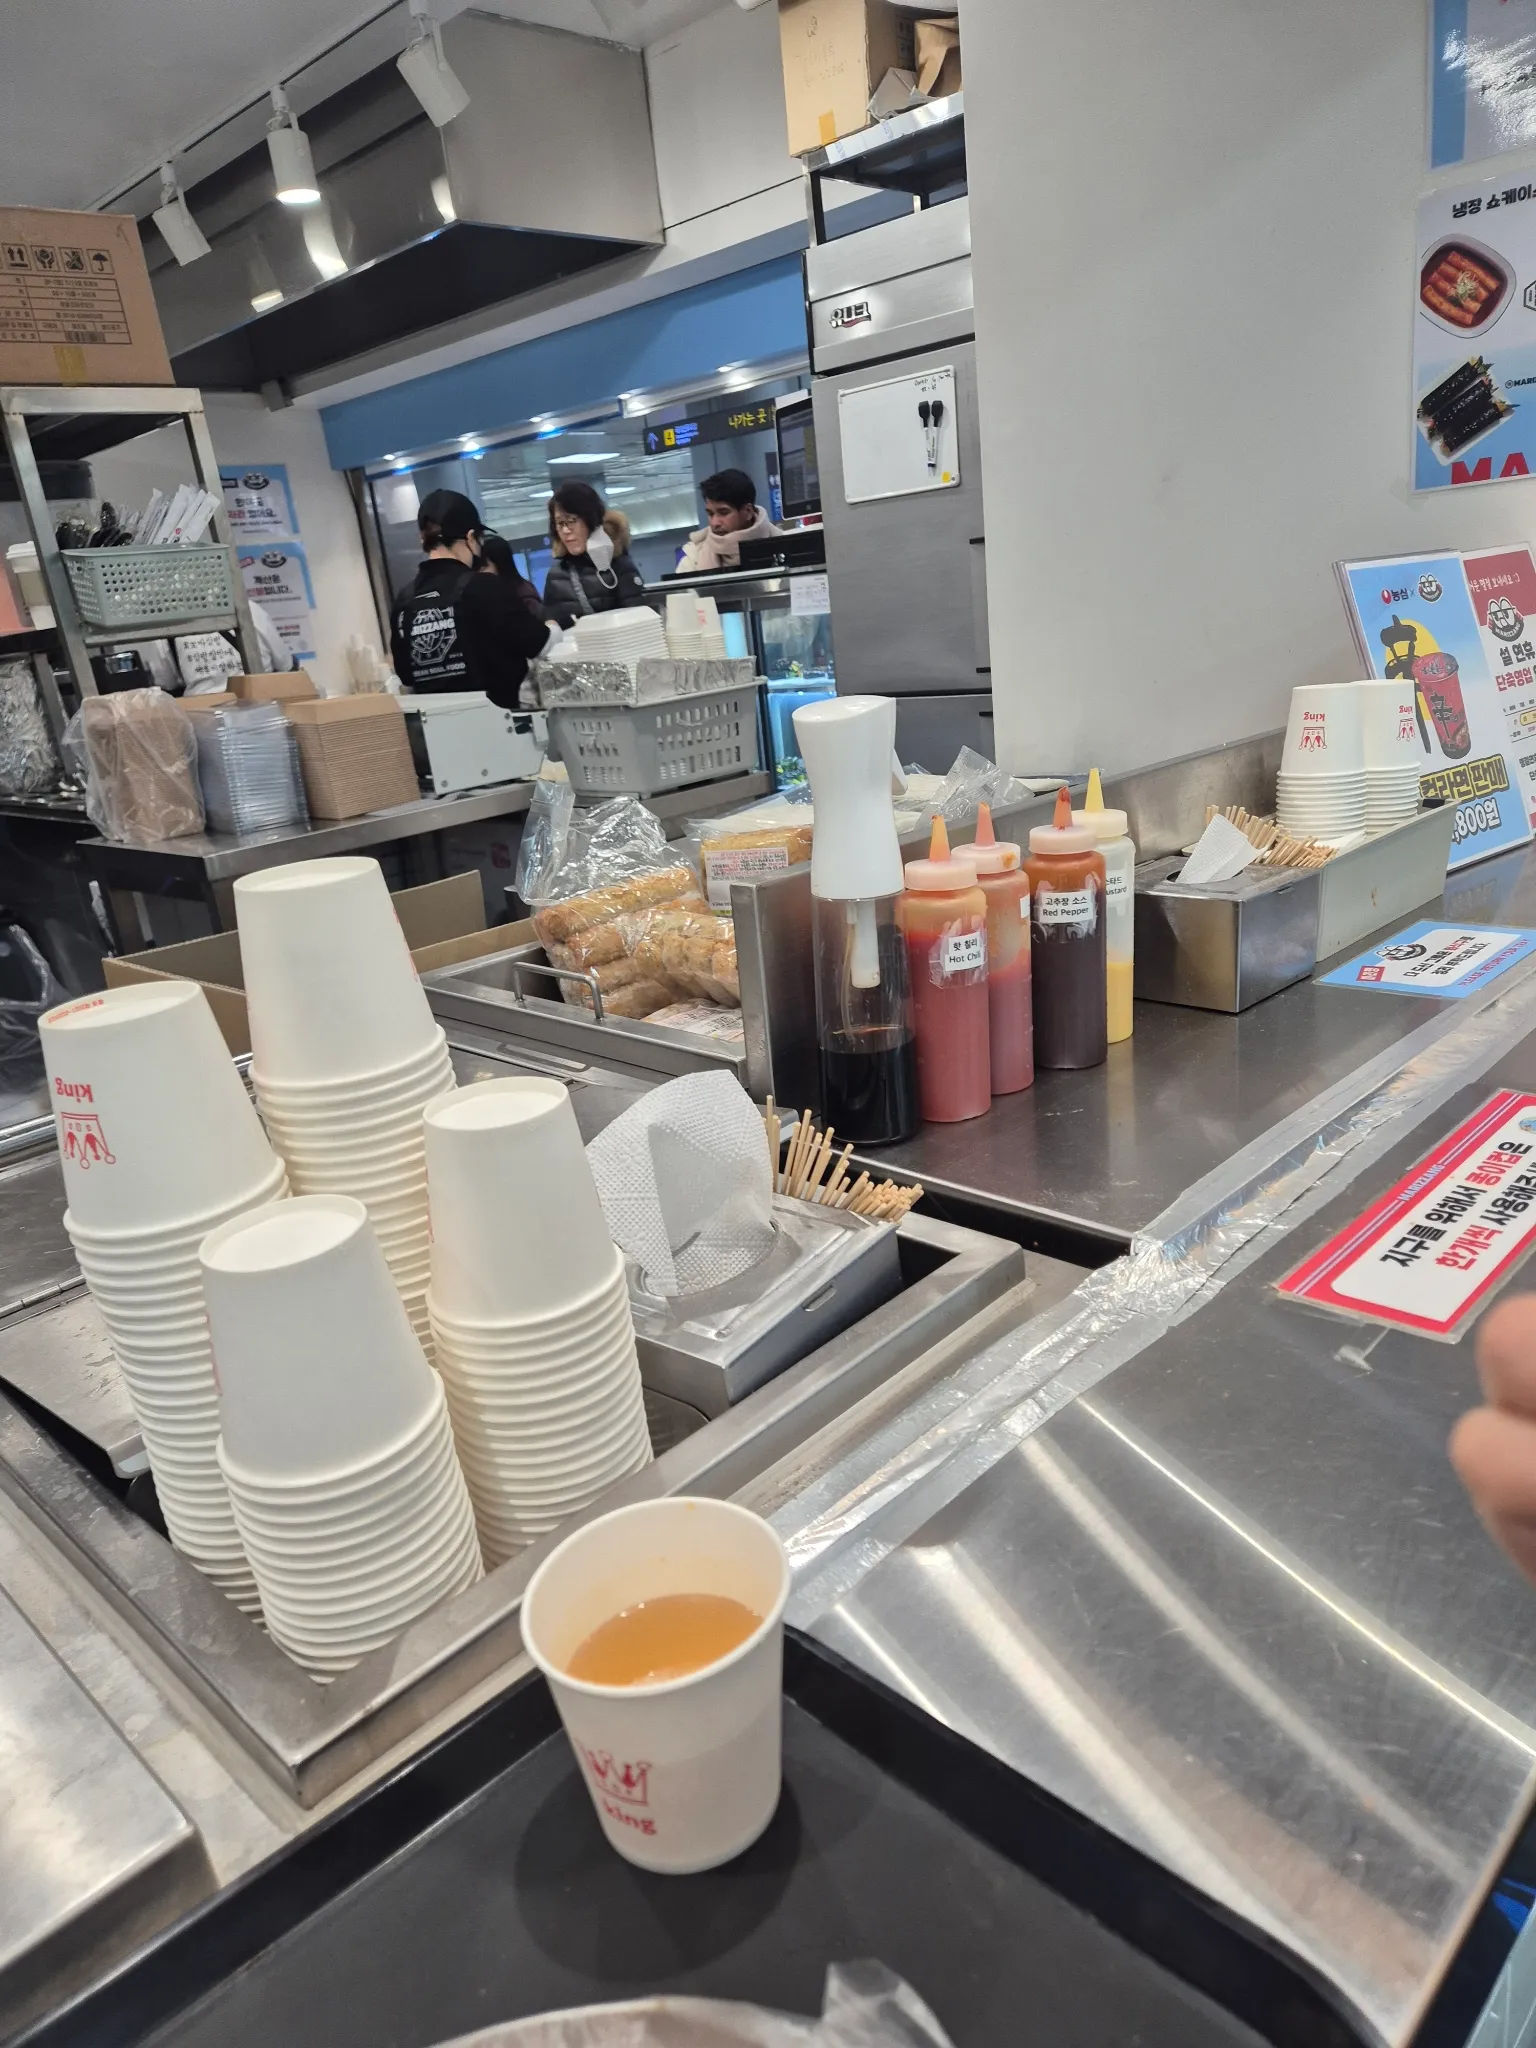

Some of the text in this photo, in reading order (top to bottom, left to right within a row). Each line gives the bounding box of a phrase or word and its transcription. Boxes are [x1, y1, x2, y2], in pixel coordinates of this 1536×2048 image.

[1452, 198, 1482, 219] 냉장
[728, 407, 768, 429] 나가는 곳
[1391, 588, 1409, 602] 농심
[1500, 641, 1536, 667] 설 연휴
[1495, 667, 1533, 692] 단축영업
[1303, 711, 1326, 722] king
[1471, 757, 1507, 793] 판매
[1452, 796, 1502, 844] ,800원
[1045, 896, 1088, 906] 고추장 소스
[1106, 886, 1127, 896] ustard
[1042, 907, 1089, 917] Red Pepper
[953, 938, 978, 952] 핫 칠리
[949, 955, 965, 963] Hot
[55, 1077, 94, 1103] king
[1399, 1163, 1446, 1202] MARIZZANG
[1379, 1141, 1533, 1267] 지구를 위해서 종이컵은
[1434, 1224, 1504, 1271] 한개씩
